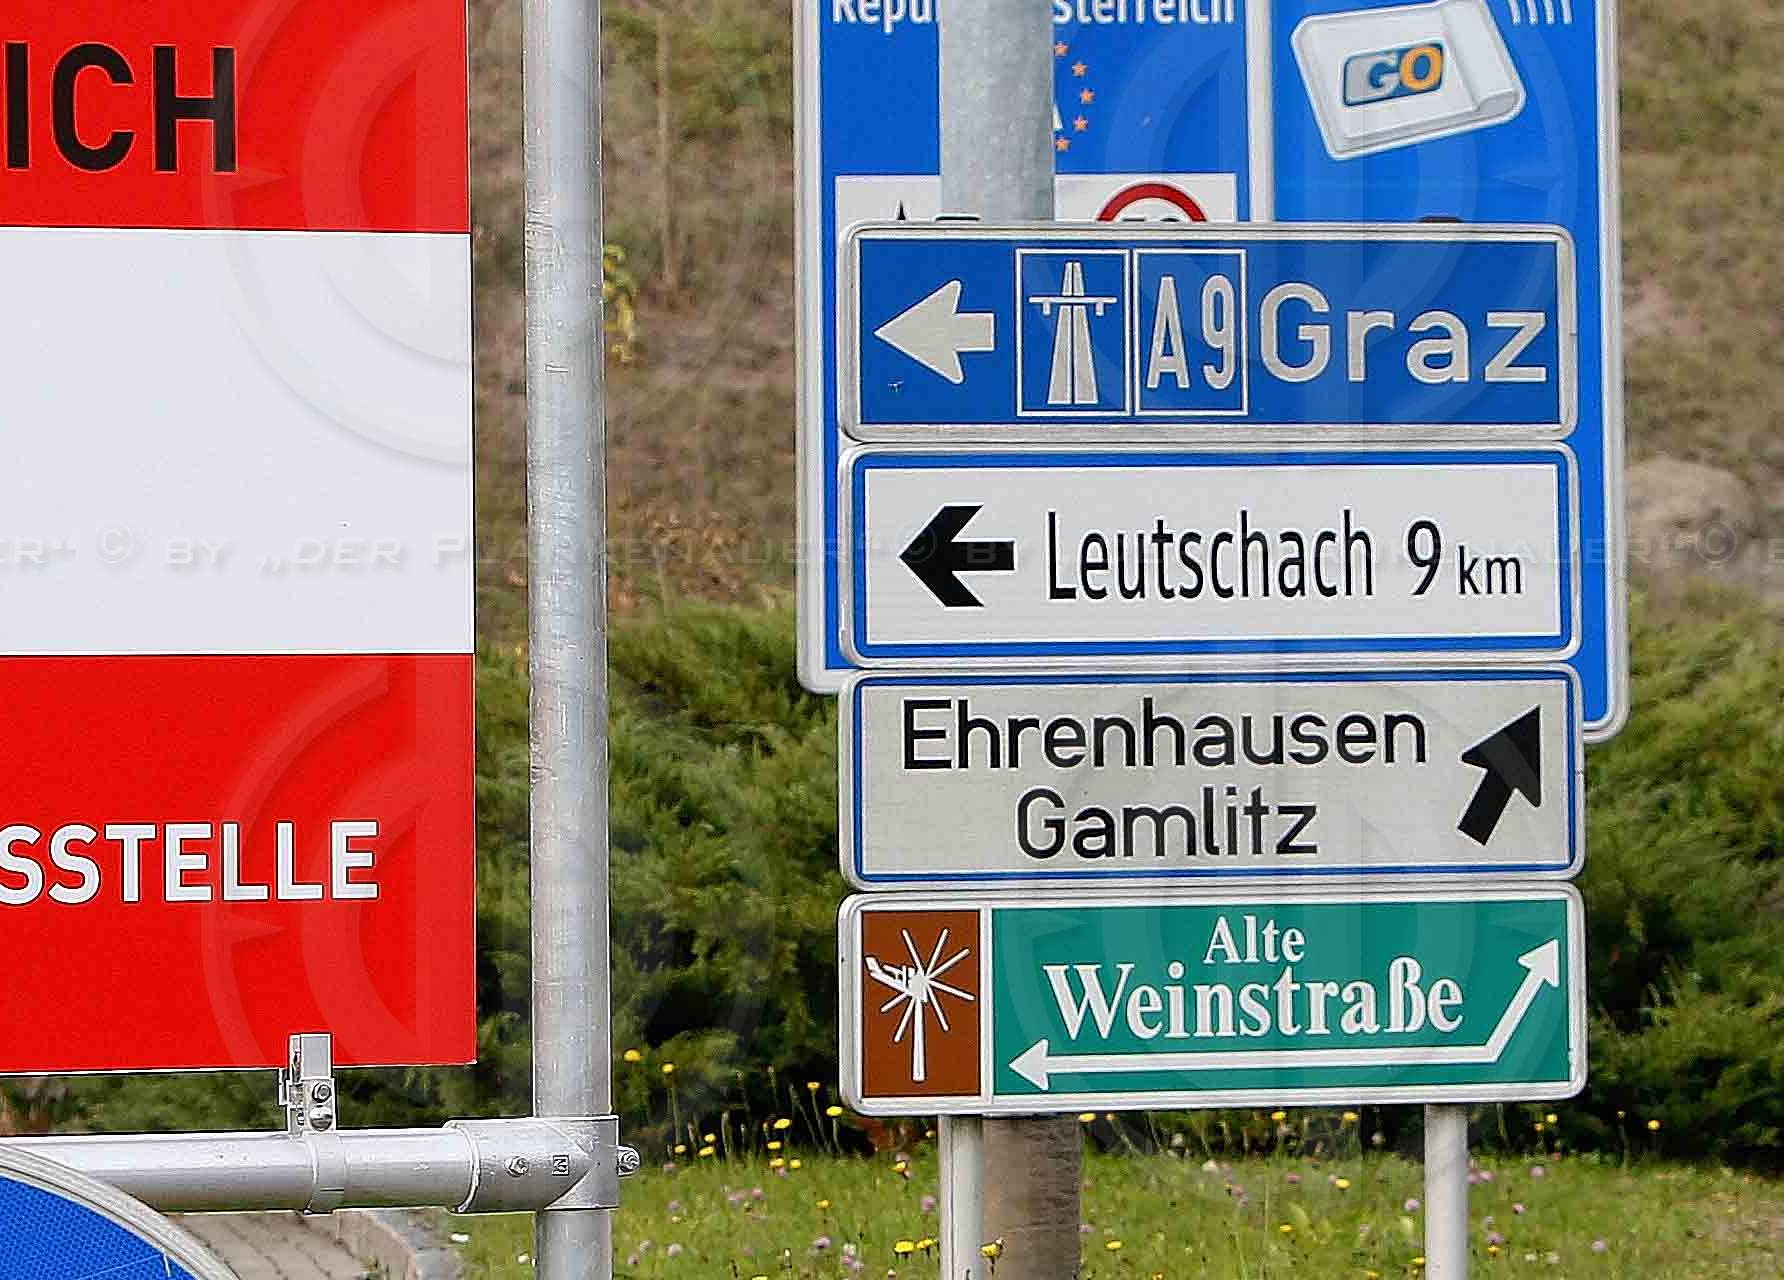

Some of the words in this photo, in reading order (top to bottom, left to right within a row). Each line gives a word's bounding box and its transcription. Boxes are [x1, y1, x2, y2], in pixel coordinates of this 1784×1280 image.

[1146, 274, 1237, 389] A9
[1258, 281, 1549, 385] Graz
[1045, 508, 1374, 601] Leutschach
[1405, 520, 1443, 597] 9
[1459, 544, 1523, 597] km
[901, 697, 1427, 772] Ehrenhausen
[1016, 785, 1319, 860] Gamlitz
[1201, 916, 1306, 965] Alte
[1042, 955, 1464, 1041] Weinstraße
